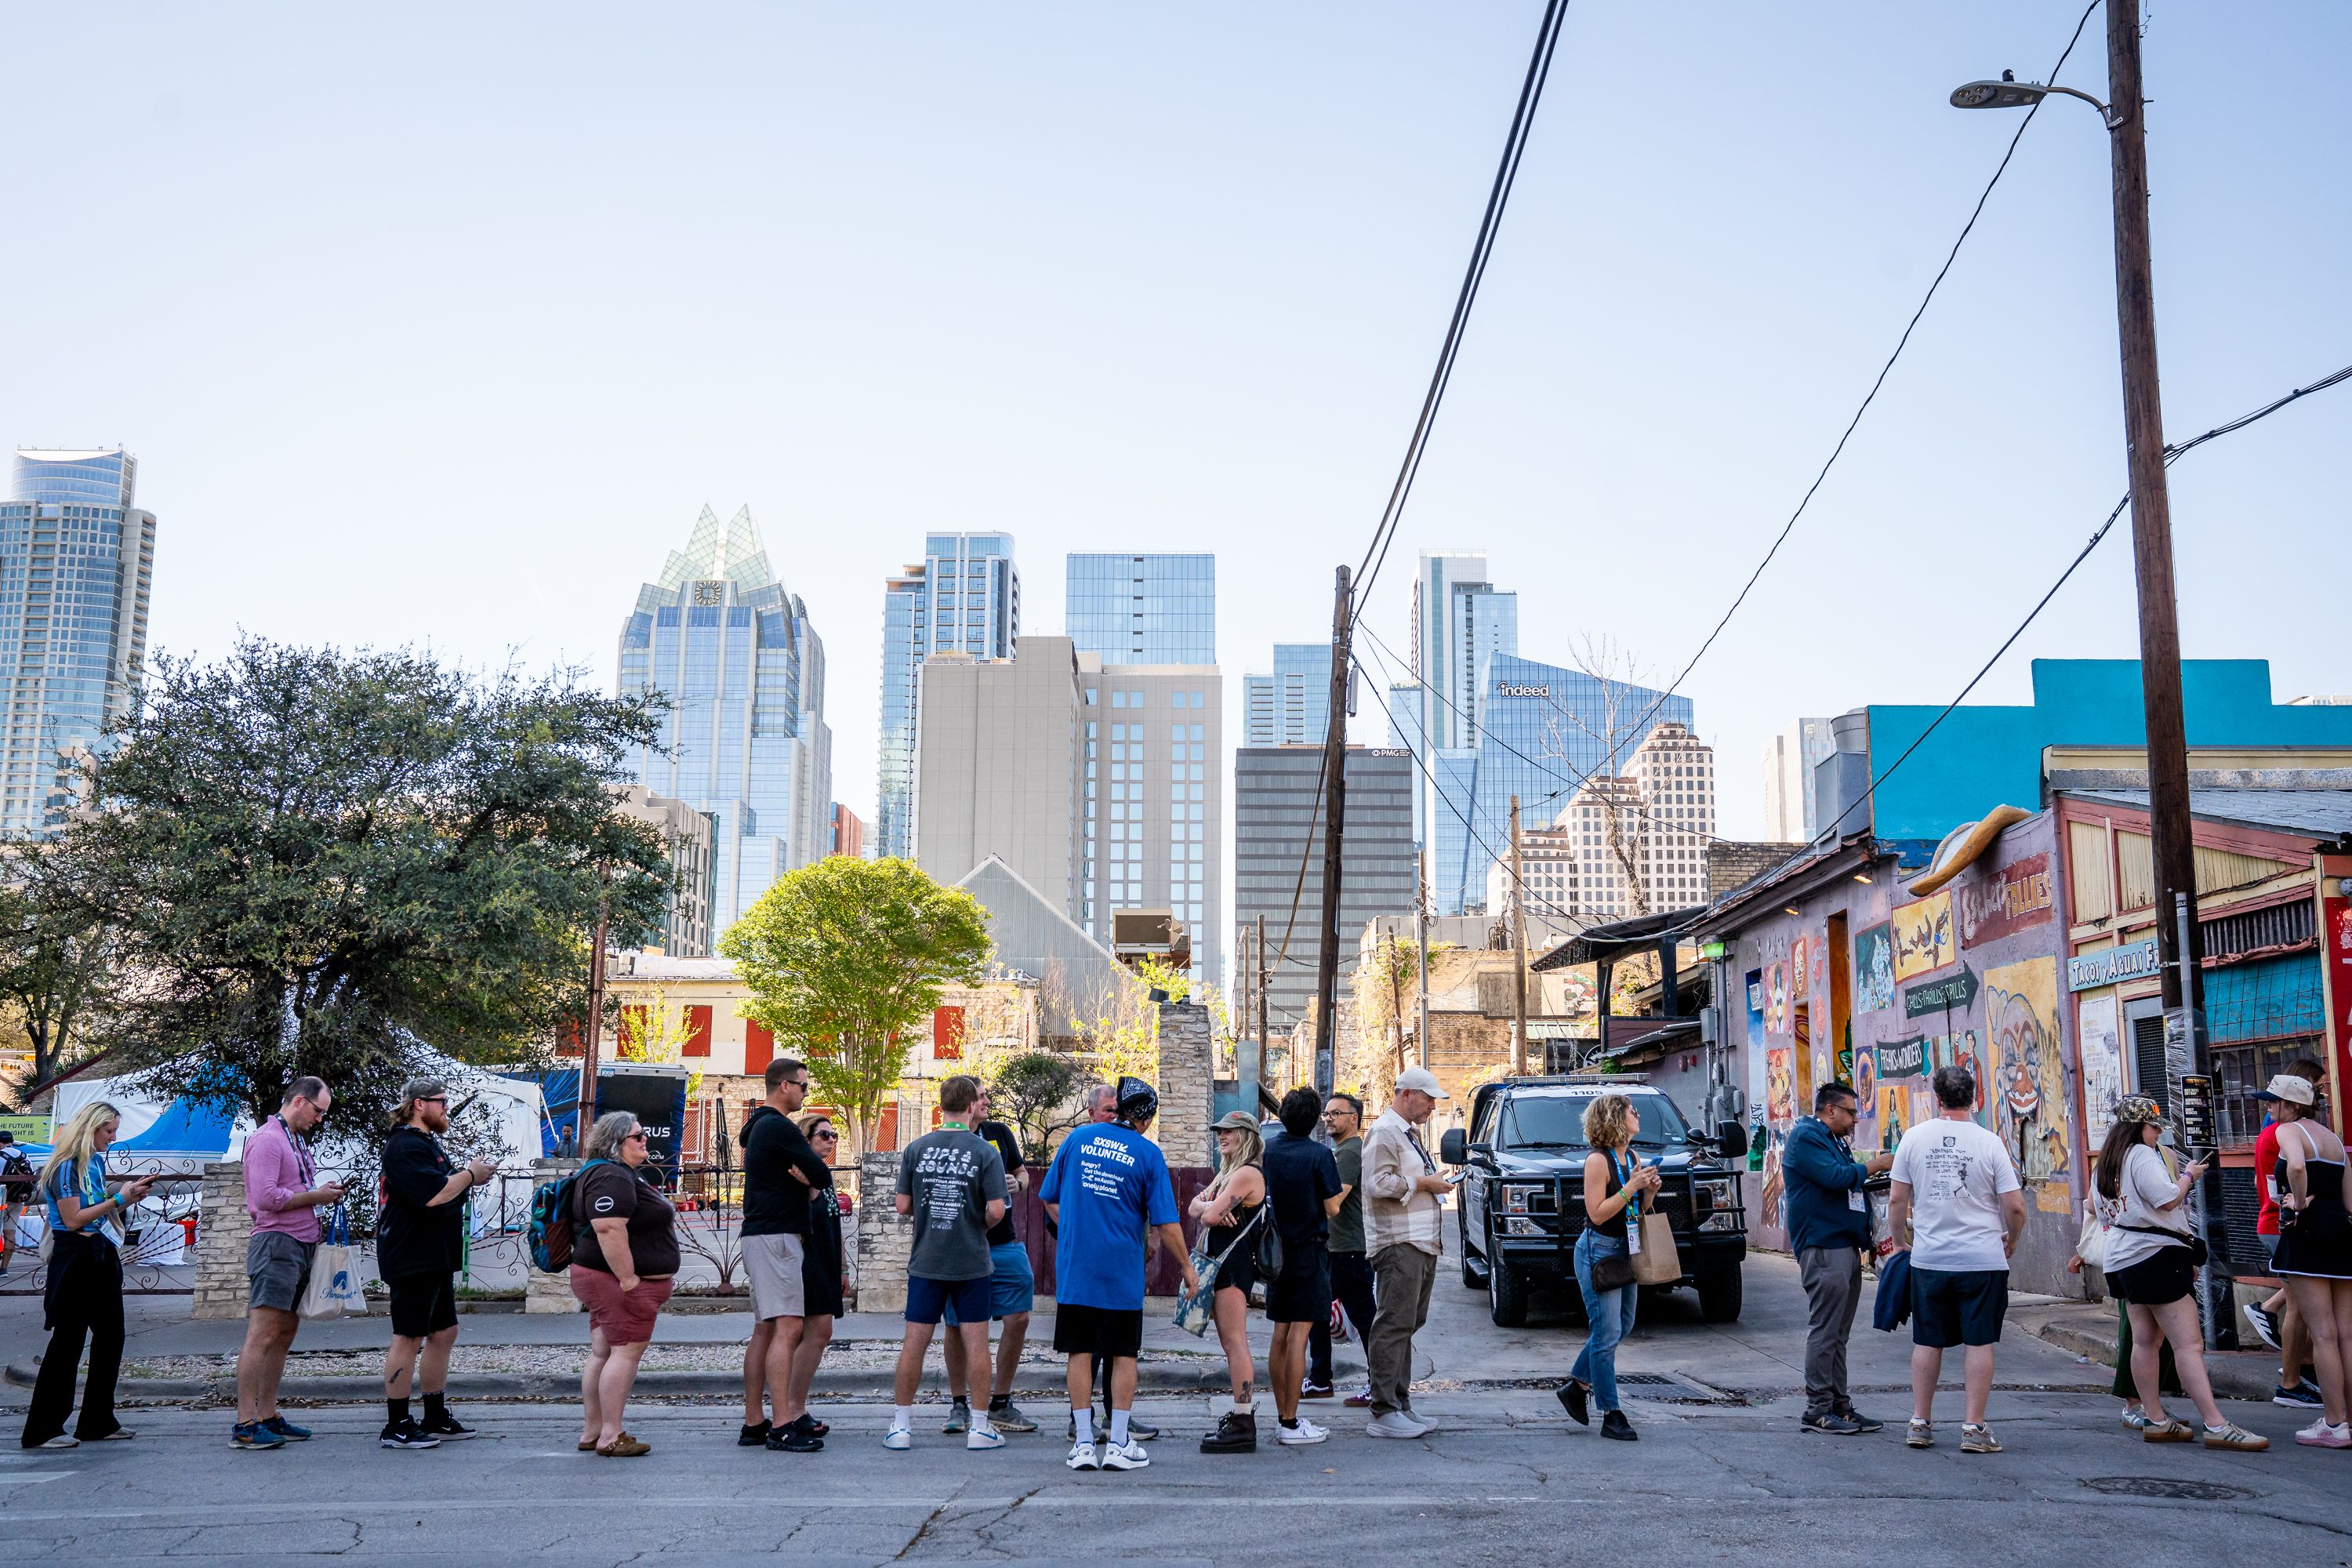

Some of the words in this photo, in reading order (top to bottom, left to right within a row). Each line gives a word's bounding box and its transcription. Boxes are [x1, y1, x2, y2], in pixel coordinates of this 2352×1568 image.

[1497, 681, 1549, 697] indeed
[2005, 869, 2052, 920] FOLLIES
[2073, 960, 2100, 986] TACOS
[2108, 951, 2143, 978] AGUAS
[2145, 942, 2160, 971] FR
[1897, 1040, 1922, 1069] WONDERS
[643, 1127, 670, 1138] RUS
[1093, 1137, 1120, 1150] SXSW
[923, 1147, 959, 1161] SIPS
[1081, 1145, 1135, 1167] VOLUNTEER
[916, 1160, 978, 1178] SOUNDS
[1081, 1160, 1101, 1169] Hungry?
[1100, 1177, 1116, 1185] Austin
[1102, 1171, 1123, 1182] download
[1083, 1181, 1099, 1191] lonely
[1099, 1184, 1117, 1194] planet
